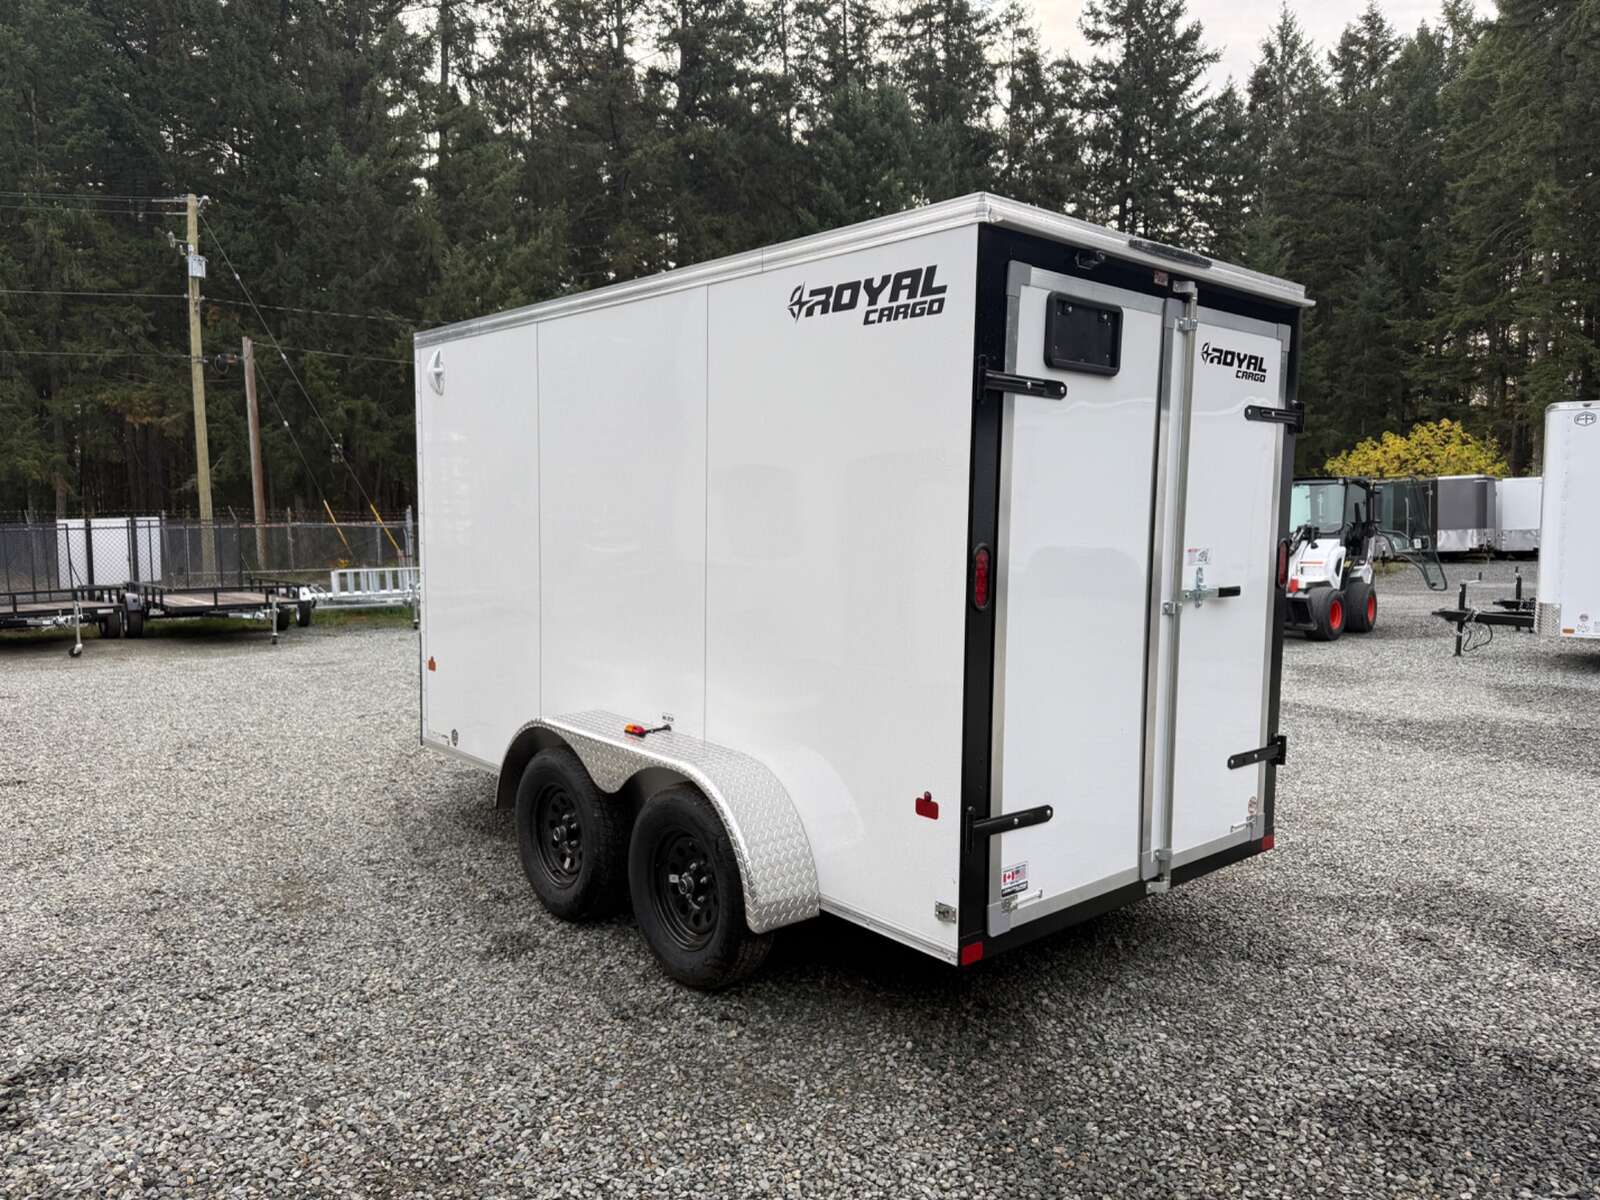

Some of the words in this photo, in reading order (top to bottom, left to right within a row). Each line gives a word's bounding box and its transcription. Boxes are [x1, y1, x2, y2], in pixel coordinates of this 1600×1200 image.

[804, 264, 948, 318] ROYAL
[863, 297, 946, 326] CARGO
[1209, 347, 1267, 373] ROYAL
[1235, 369, 1267, 383] CARGO
